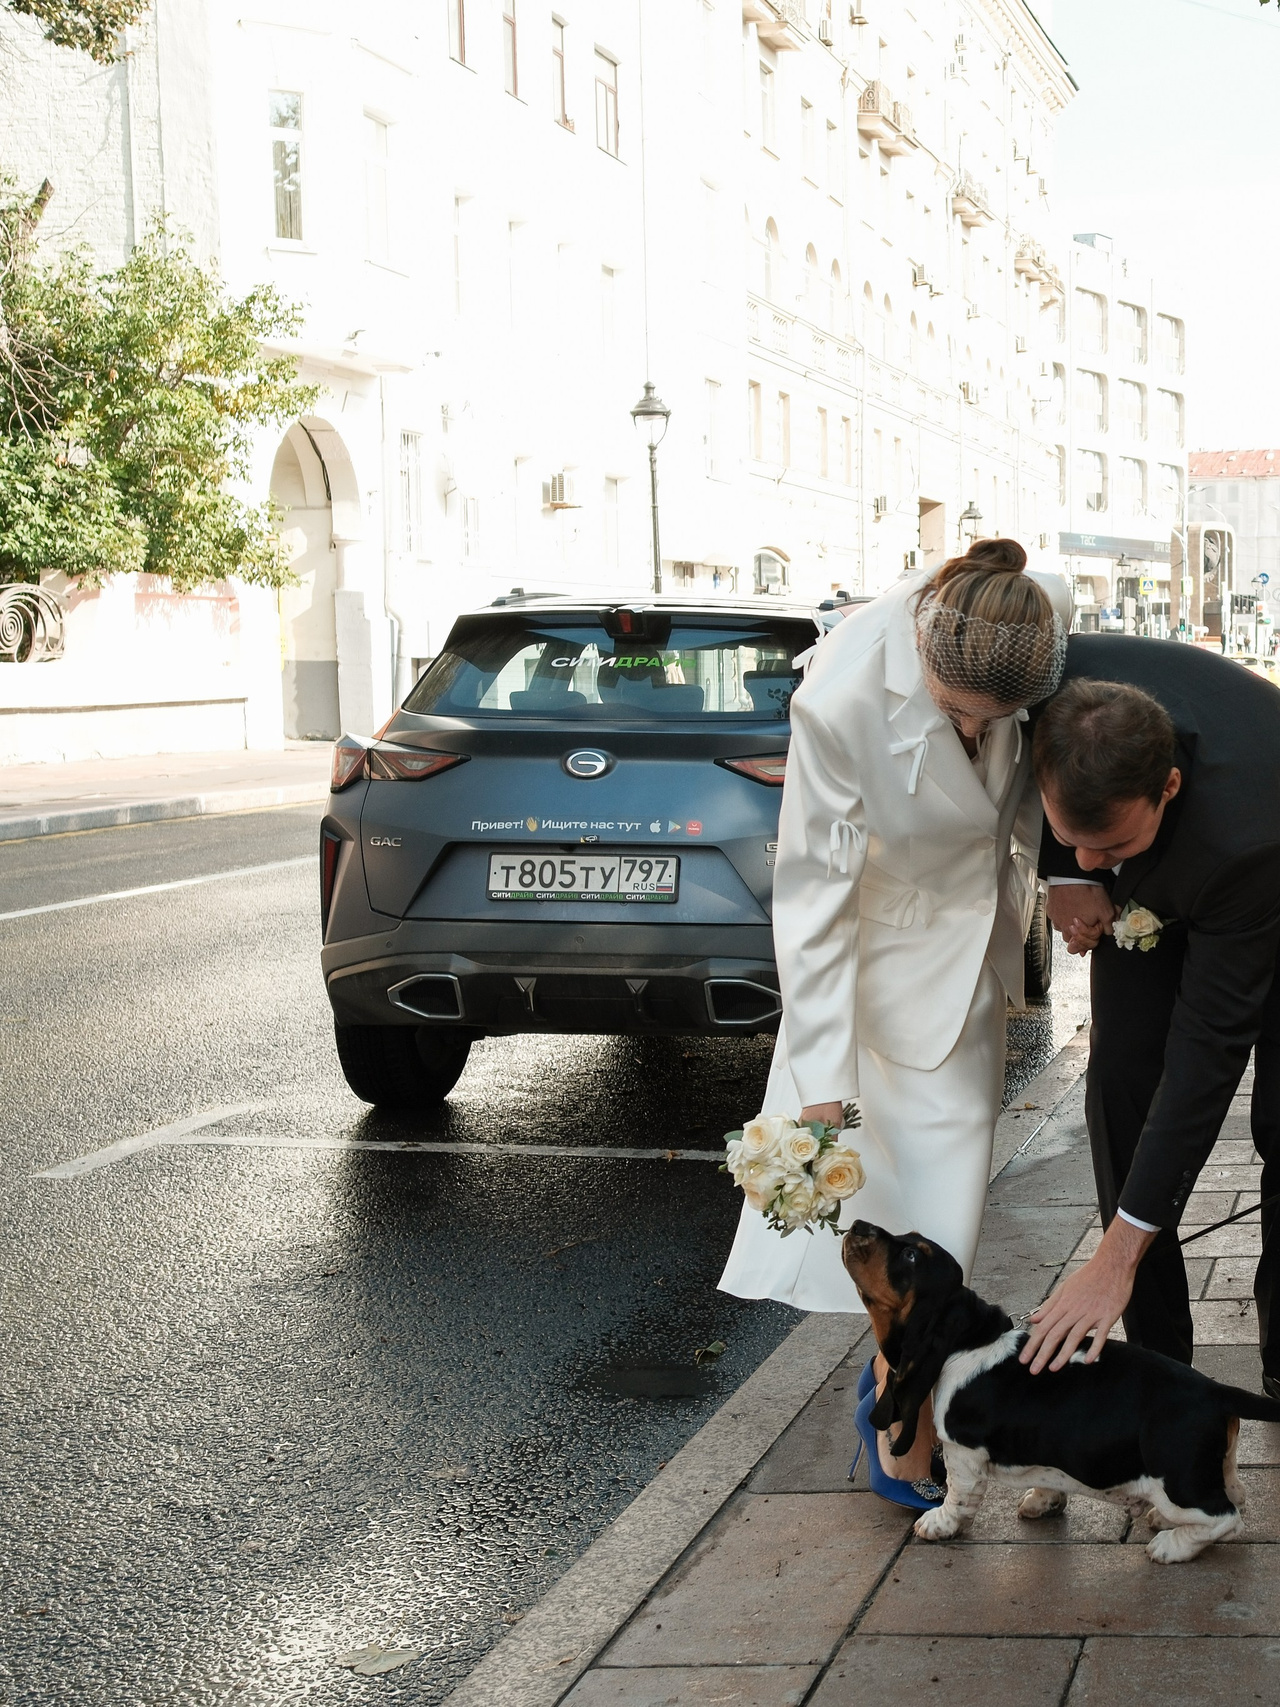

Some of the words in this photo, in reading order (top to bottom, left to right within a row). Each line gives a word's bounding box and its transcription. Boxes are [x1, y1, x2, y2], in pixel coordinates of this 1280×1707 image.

[471, 820, 524, 832] Привет!
[541, 820, 588, 830] Ищите
[590, 821, 614, 830] нас
[617, 822, 641, 832] тут
[370, 836, 402, 847] GAC
[623, 859, 670, 883] 797
[632, 882, 656, 891] RUS
